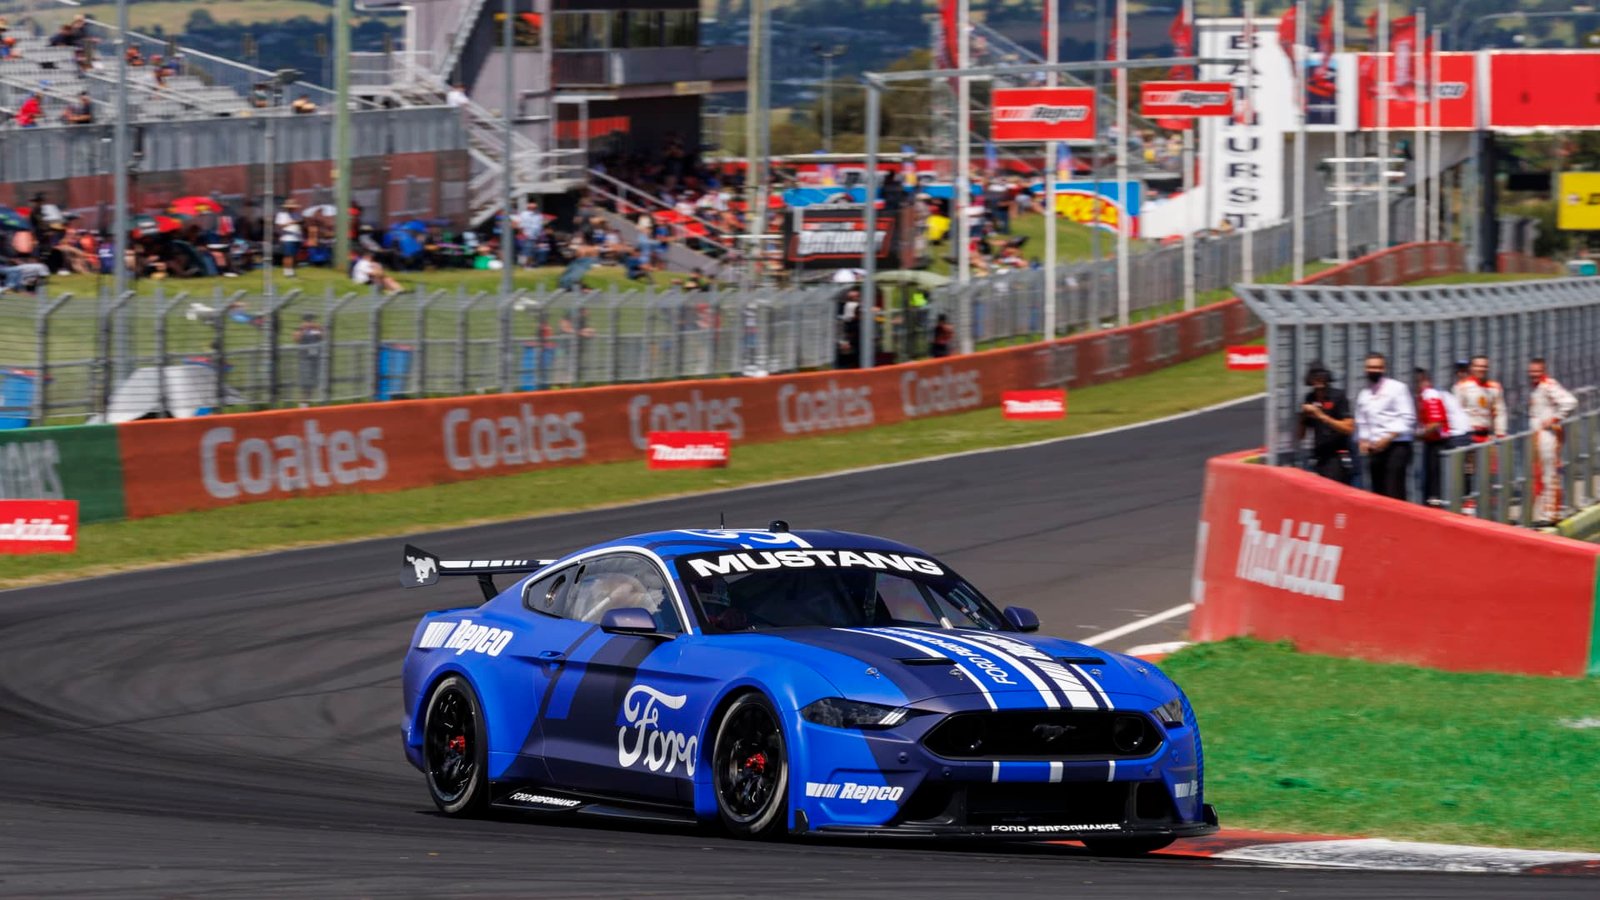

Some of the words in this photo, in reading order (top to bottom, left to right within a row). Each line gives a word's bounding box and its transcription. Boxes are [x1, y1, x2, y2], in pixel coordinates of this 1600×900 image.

[777, 379, 875, 433] Coates
[900, 362, 981, 417] Coates
[442, 403, 587, 471] Coates
[201, 419, 388, 499] Coates
[0, 517, 72, 541] akita
[687, 549, 945, 578] MUSTANG
[446, 619, 515, 657] Repco
[968, 656, 1018, 685] FORD
[838, 781, 905, 804] Repco
[990, 824, 1027, 833] FORD
[1027, 822, 1122, 833] PERFORMANCE
